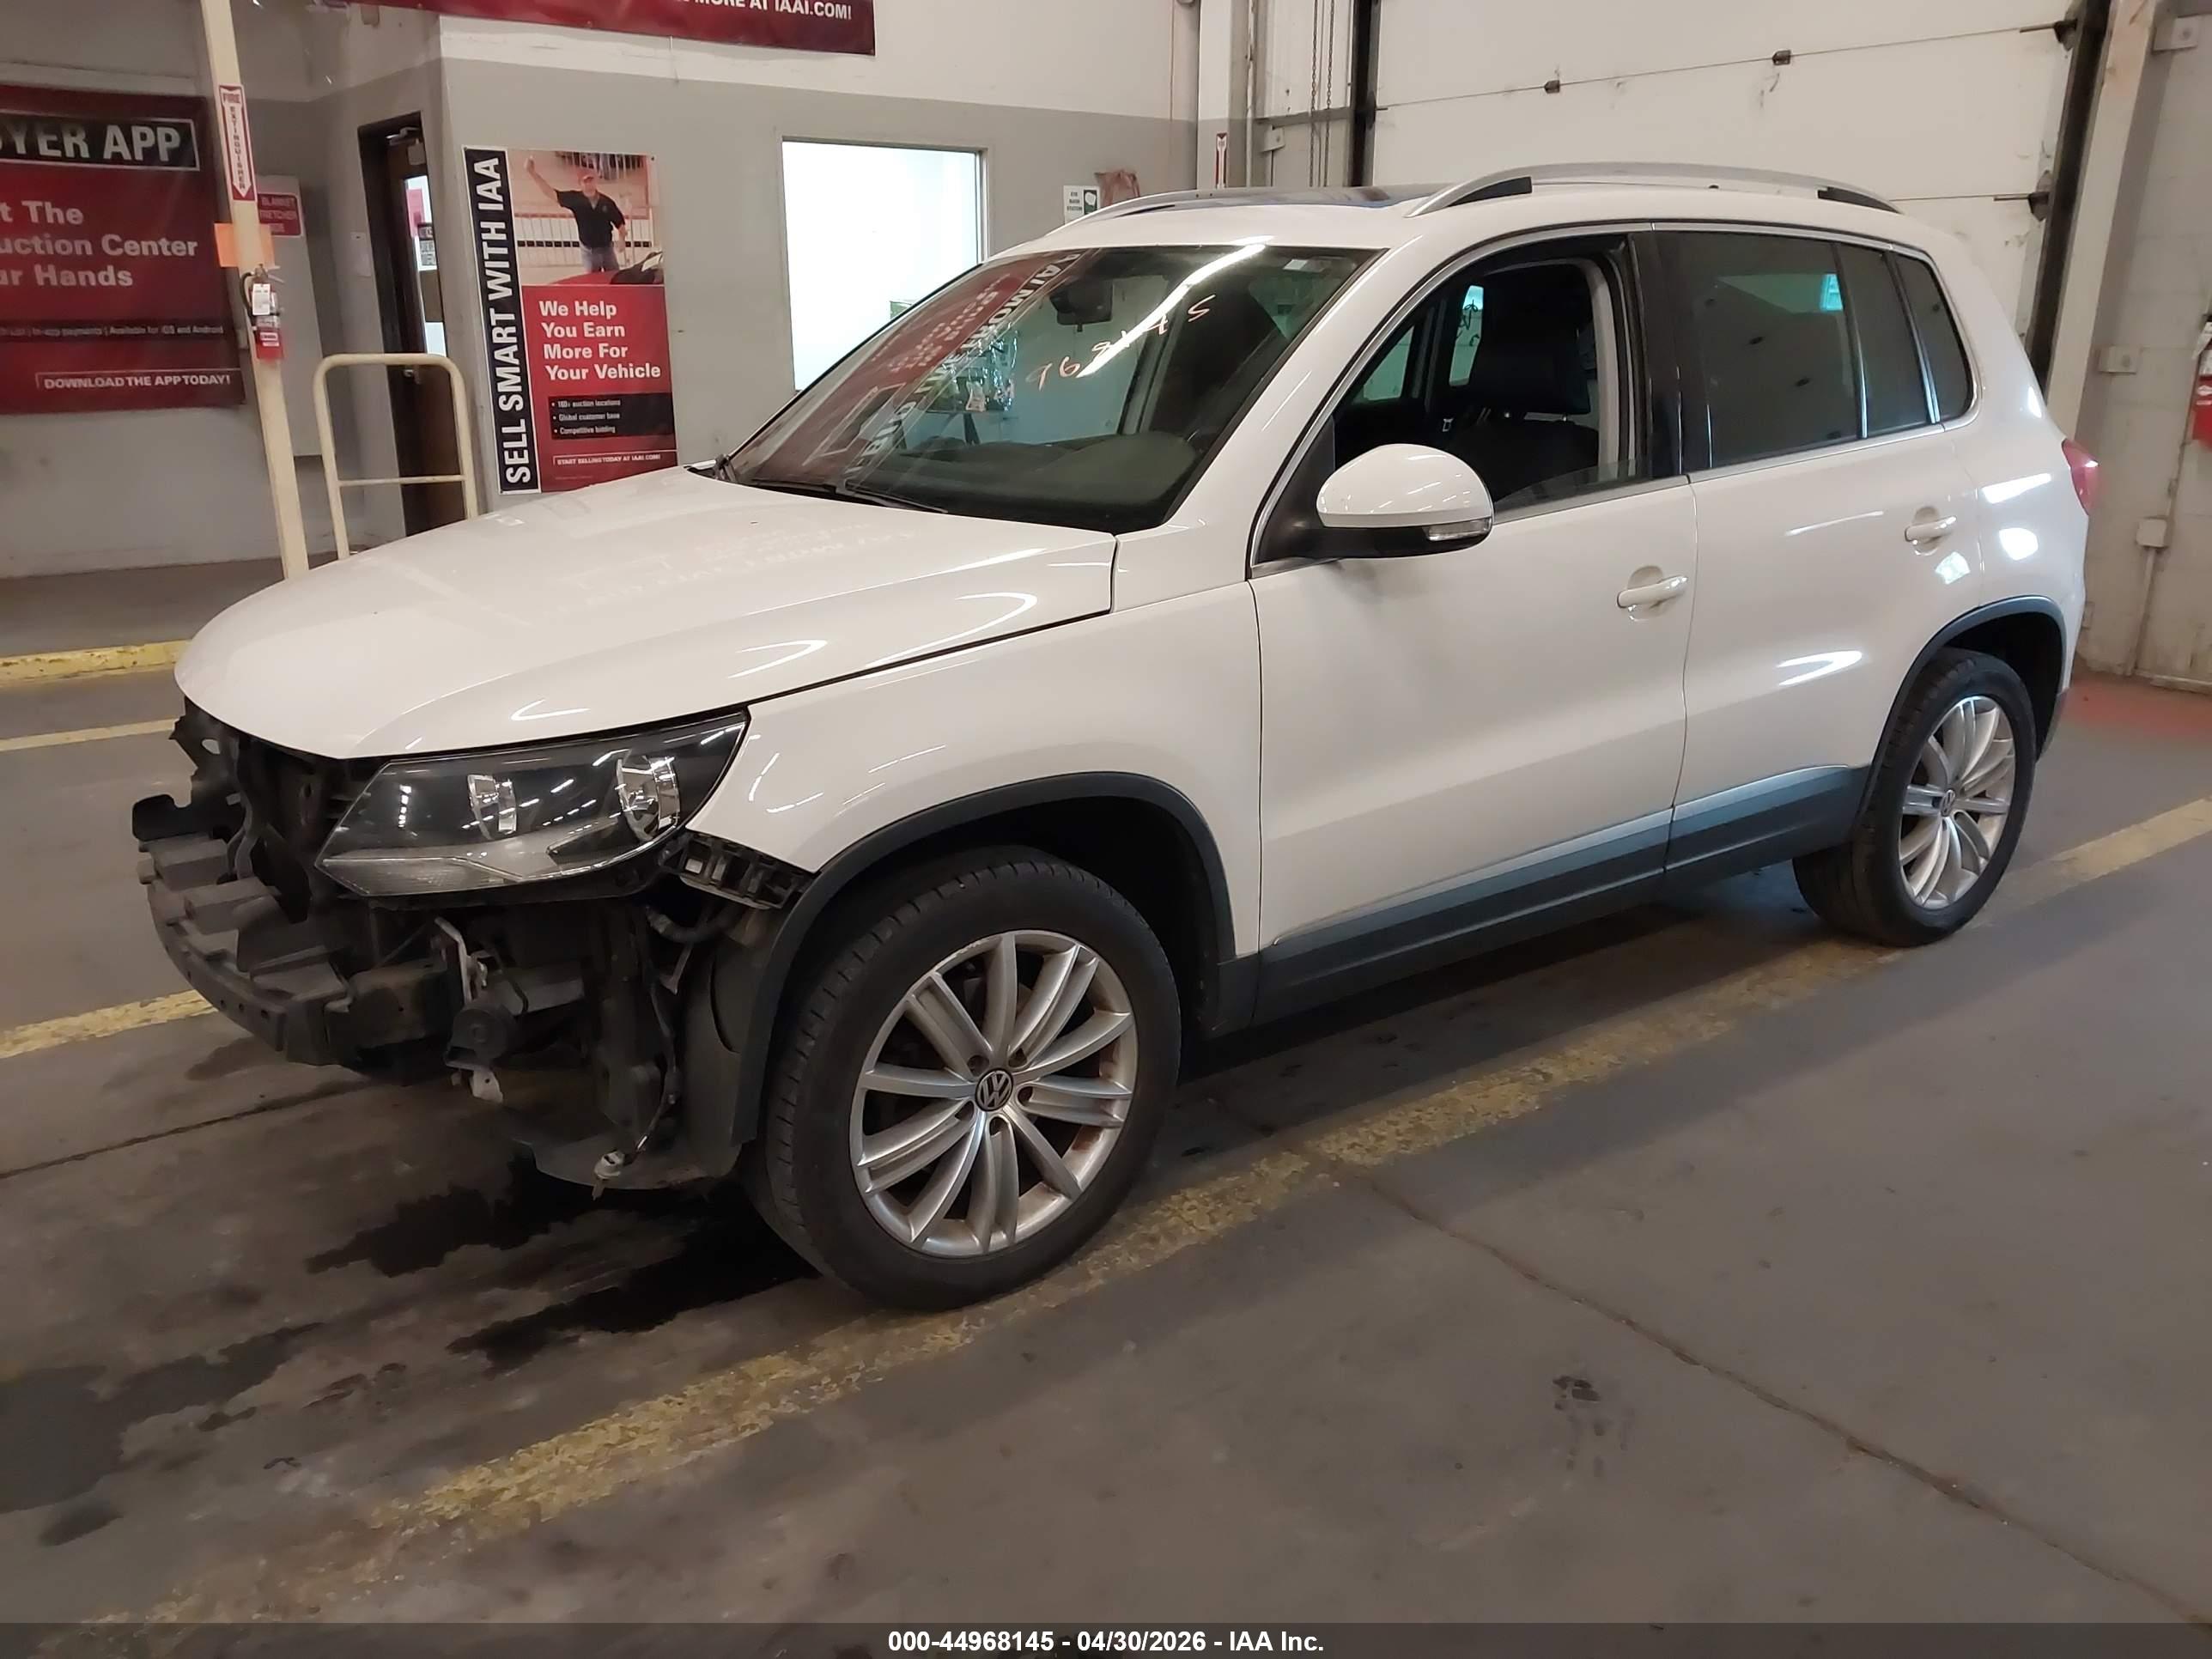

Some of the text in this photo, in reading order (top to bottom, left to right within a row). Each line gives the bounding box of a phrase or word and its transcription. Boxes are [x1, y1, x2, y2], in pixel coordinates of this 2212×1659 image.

[775, 0, 851, 20] IAAI.COM!
[223, 94, 240, 104] FIRE
[0, 121, 181, 161] YER APP
[21, 200, 83, 224] The
[101, 233, 198, 256] Center
[34, 264, 134, 287] Hands
[539, 301, 617, 319] We Help
[474, 157, 531, 483] SELL SMART WITH IAA
[541, 322, 625, 337] You Earn
[544, 343, 628, 359] More For
[545, 362, 661, 380] Your Vehicle
[44, 374, 230, 389] DOWNLOAD THE APP TODAY!
